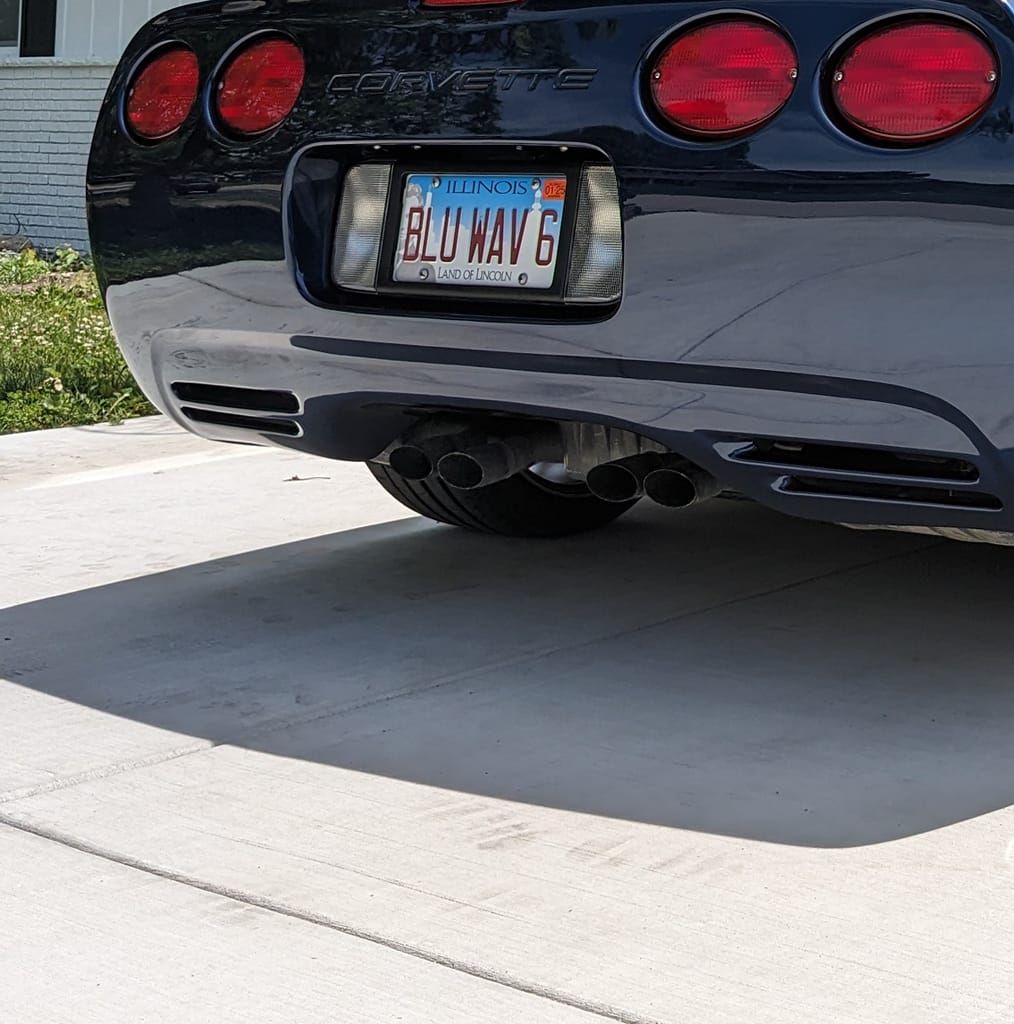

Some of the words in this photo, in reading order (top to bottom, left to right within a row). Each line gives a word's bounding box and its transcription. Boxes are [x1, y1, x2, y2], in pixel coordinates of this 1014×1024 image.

[326, 67, 599, 92] CORVETTE
[446, 180, 528, 195] ILLINOIS
[403, 207, 462, 263] BLU
[468, 207, 529, 265] WAV
[535, 209, 558, 266] 6
[476, 268, 512, 282] LINCOLN
